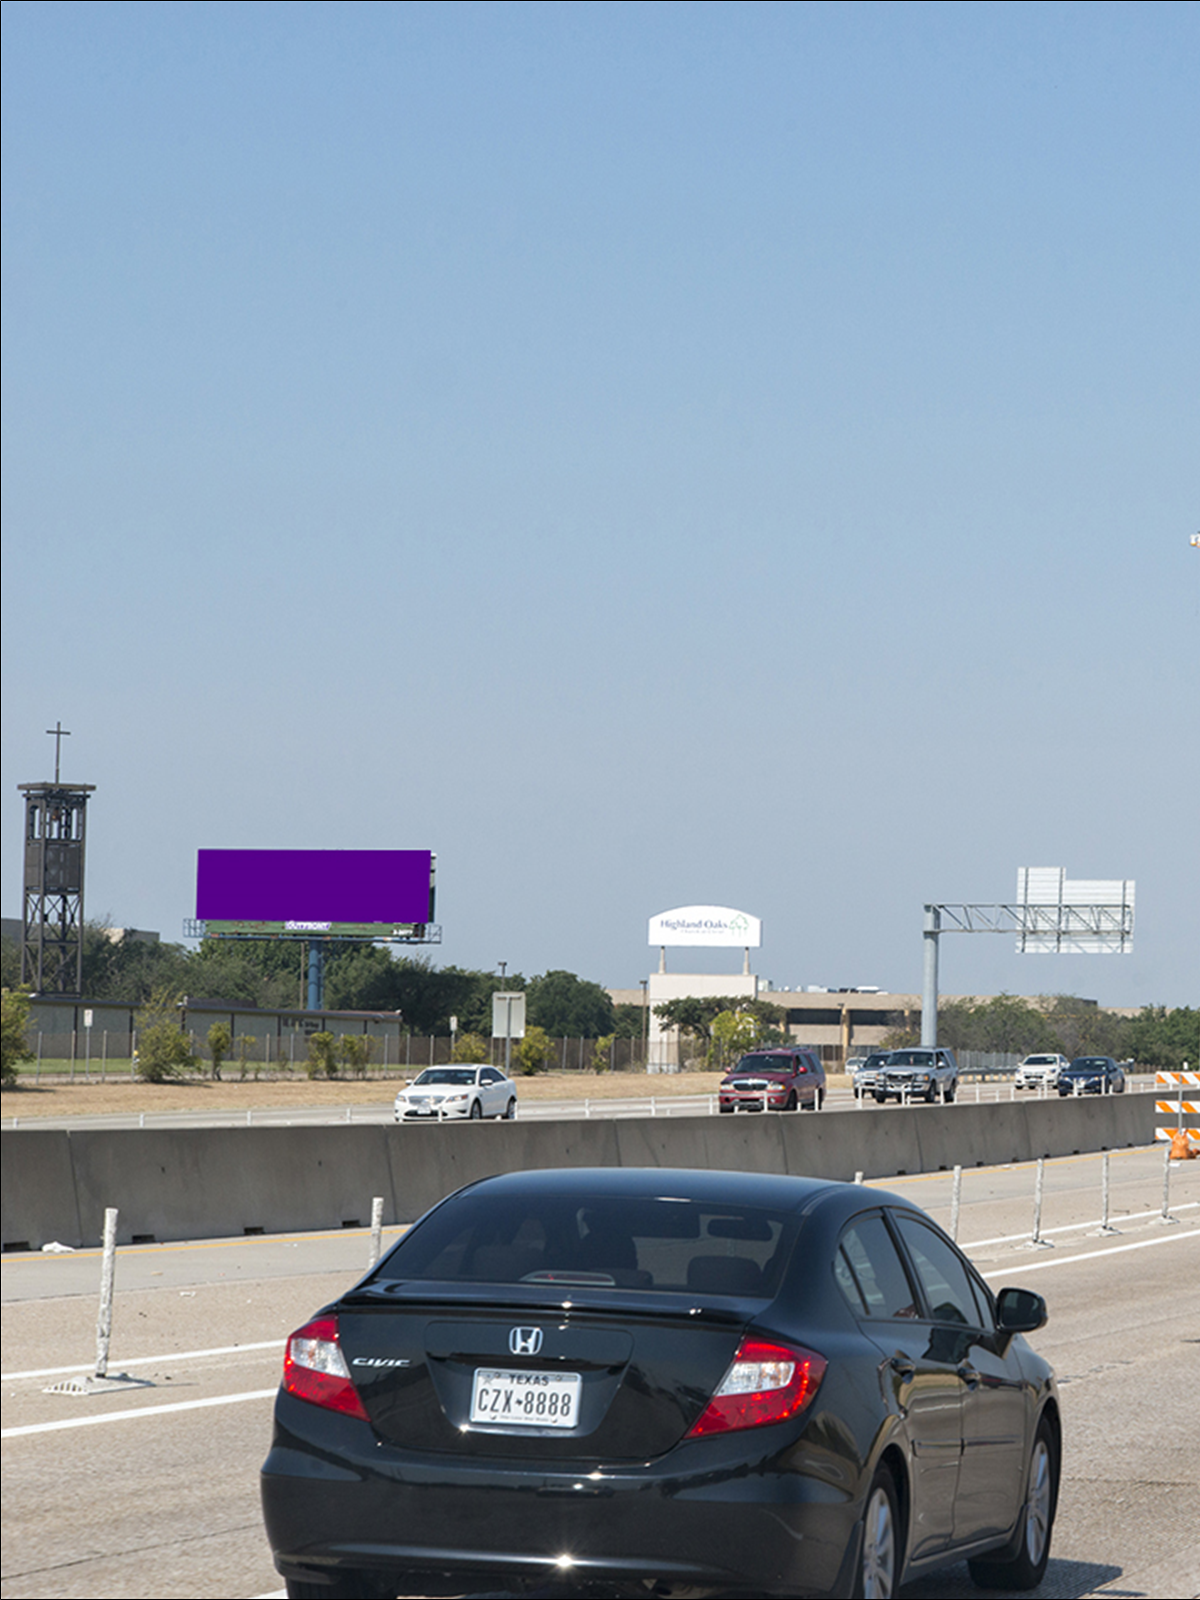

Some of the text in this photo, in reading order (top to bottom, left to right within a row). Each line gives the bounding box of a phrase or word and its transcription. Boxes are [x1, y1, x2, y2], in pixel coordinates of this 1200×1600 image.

[661, 919, 728, 930] Highland Oaks
[352, 1357, 411, 1368] CIVIC
[509, 1373, 549, 1386] TEXAS
